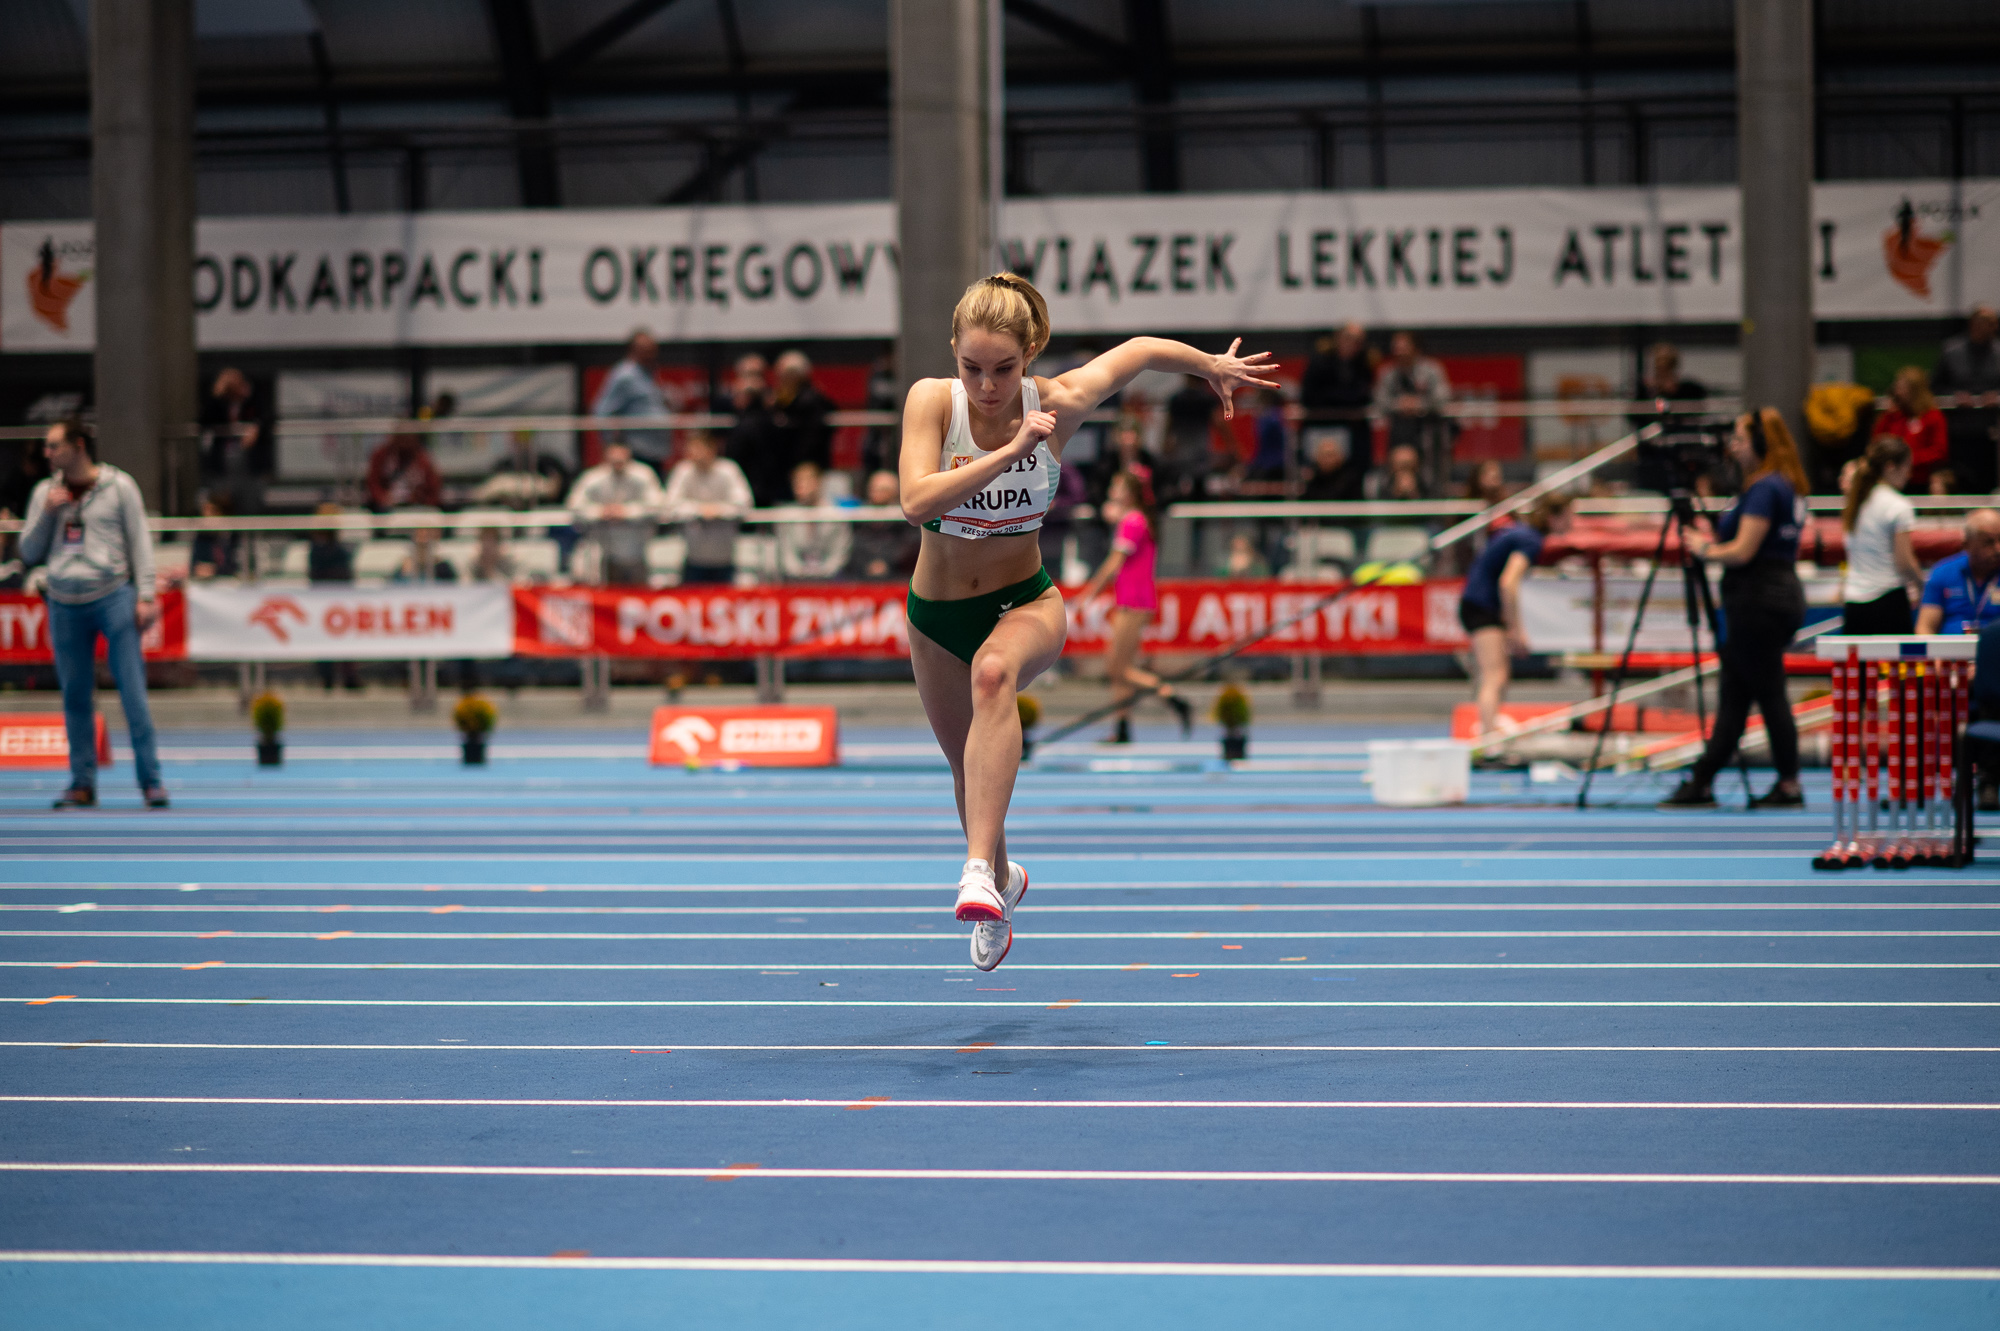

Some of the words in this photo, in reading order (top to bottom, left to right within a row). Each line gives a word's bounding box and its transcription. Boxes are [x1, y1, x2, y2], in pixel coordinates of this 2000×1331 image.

[194, 248, 545, 311] ODKARPACKI
[999, 230, 1238, 301] WIĄZEK
[1277, 224, 1515, 289] LEKKIEJ
[1554, 220, 1837, 288] ATLETI
[323, 604, 454, 637] ORLEN
[616, 597, 781, 645] POLSKI
[1187, 592, 1398, 642] ATLETYKI
